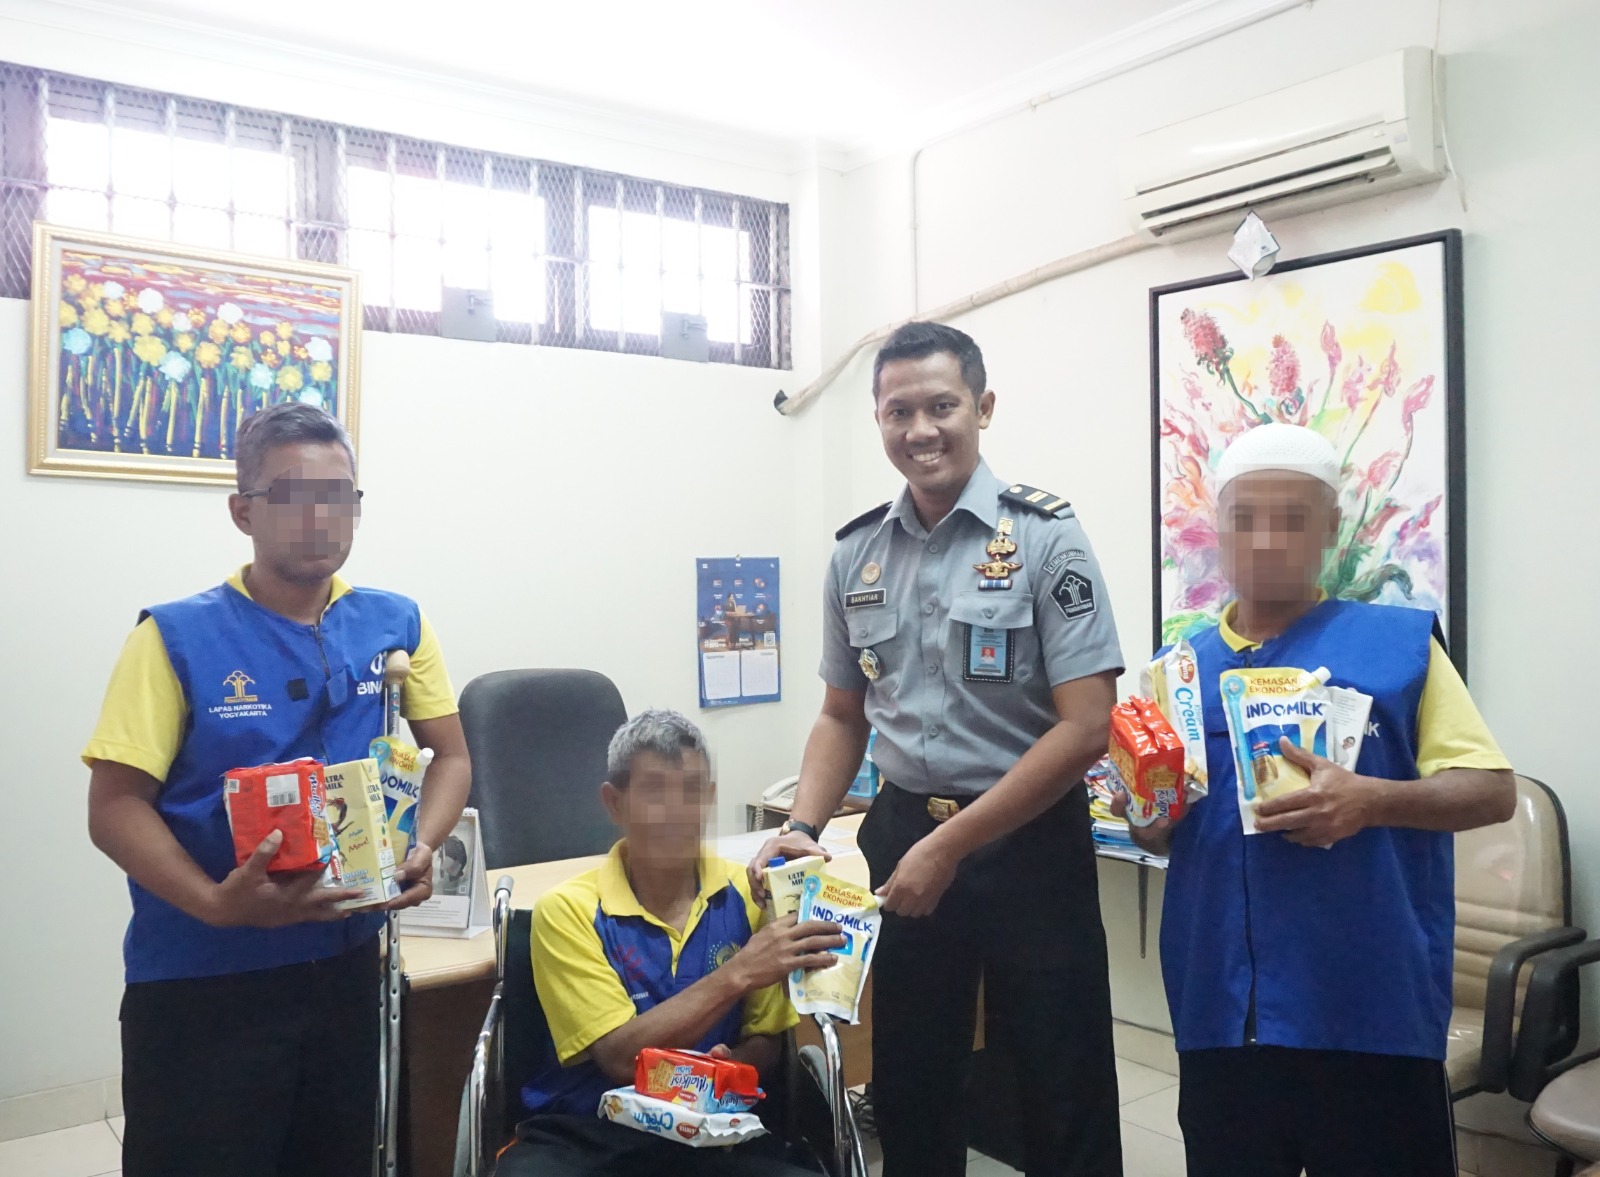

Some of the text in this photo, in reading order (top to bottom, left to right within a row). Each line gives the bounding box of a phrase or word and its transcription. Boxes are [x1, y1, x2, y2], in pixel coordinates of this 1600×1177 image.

[1250, 677, 1298, 686] KEMASAN
[208, 703, 272, 713] LAPAS NARKOTIKA
[219, 710, 268, 719] YOGYAKARTA
[1174, 687, 1201, 741] Cream
[1246, 700, 1324, 719] INDOMILK
[788, 870, 805, 880] ULTR
[825, 884, 863, 902] KEMASAN
[812, 905, 873, 933] INDOMILK
